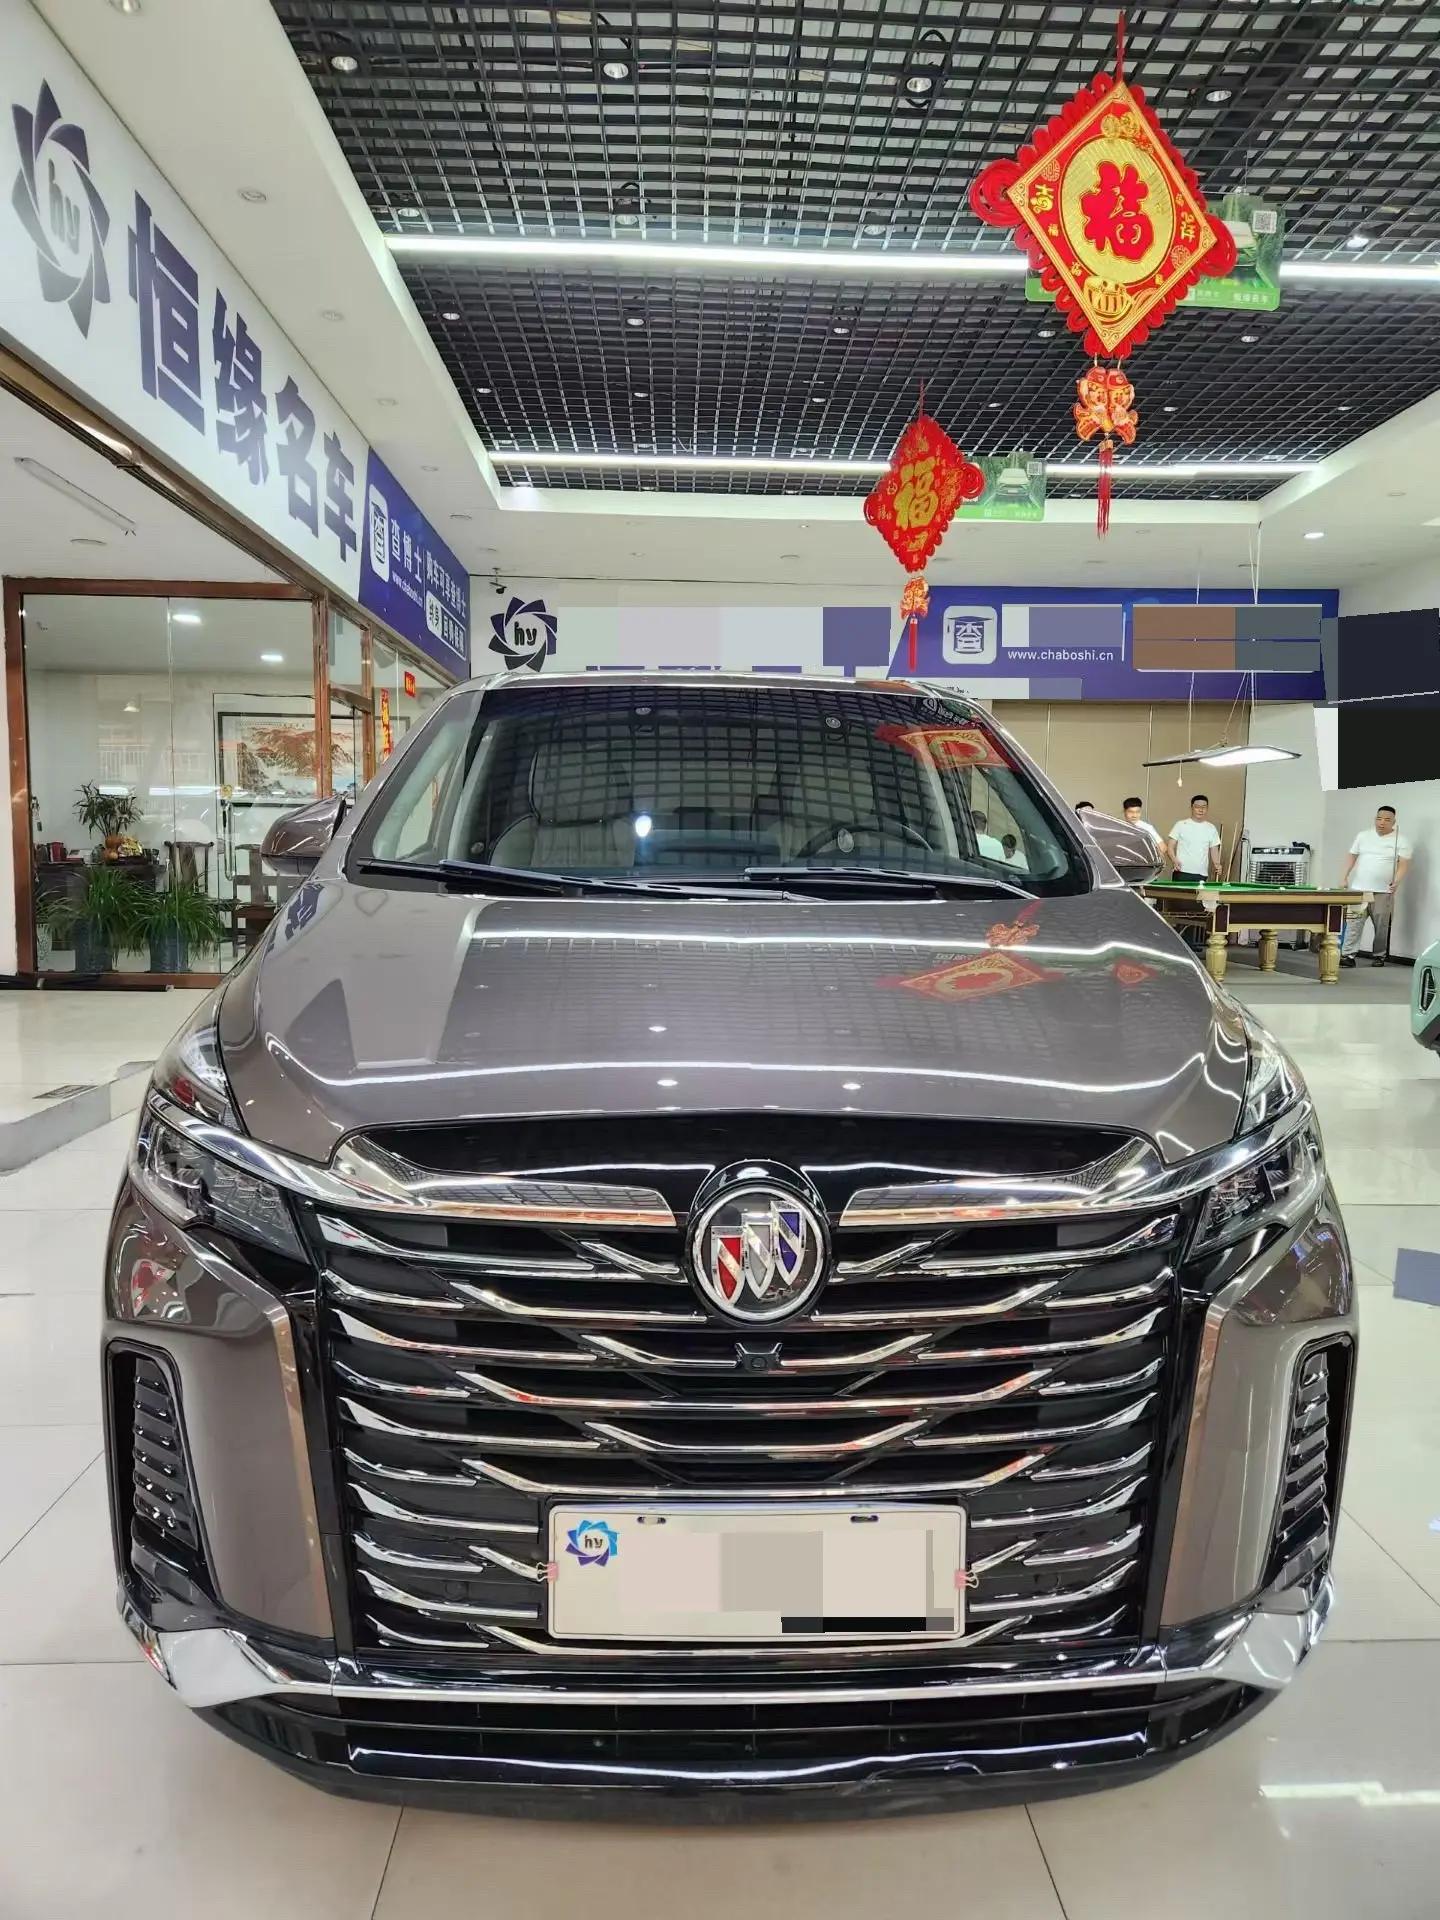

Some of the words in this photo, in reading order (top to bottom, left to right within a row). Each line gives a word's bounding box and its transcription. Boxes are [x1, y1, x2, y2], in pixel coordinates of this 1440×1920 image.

[48, 157, 81, 255] hy
[127, 189, 357, 563] 恒缘名车
[893, 456, 939, 531] 福
[391, 518, 422, 584] 查博士
[514, 621, 538, 646] hy
[1007, 648, 1114, 662] www.chaboshi.cn
[584, 1535, 604, 1549] hy
